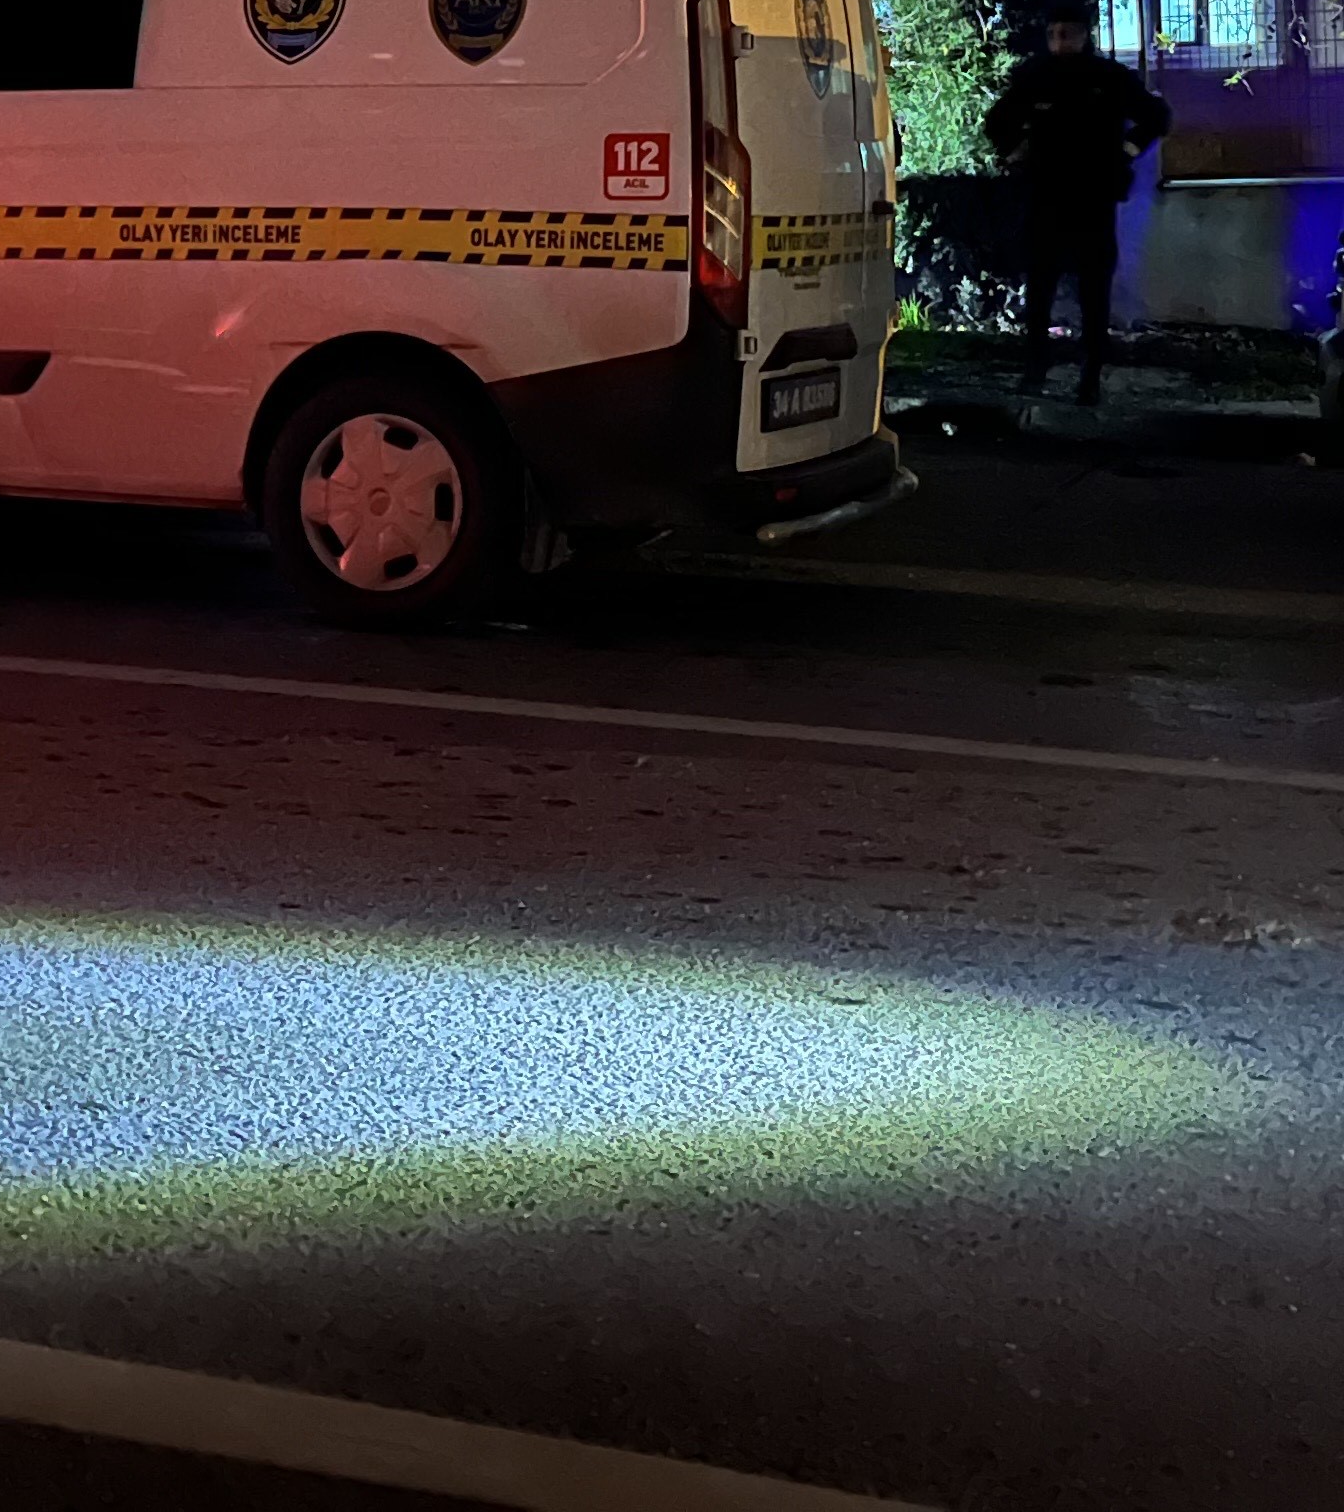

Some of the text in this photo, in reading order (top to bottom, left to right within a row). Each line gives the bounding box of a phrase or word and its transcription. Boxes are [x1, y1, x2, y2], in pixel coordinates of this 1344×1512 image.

[613, 140, 660, 171] 112
[119, 223, 165, 242] OLAY
[470, 228, 519, 248] OLAY
